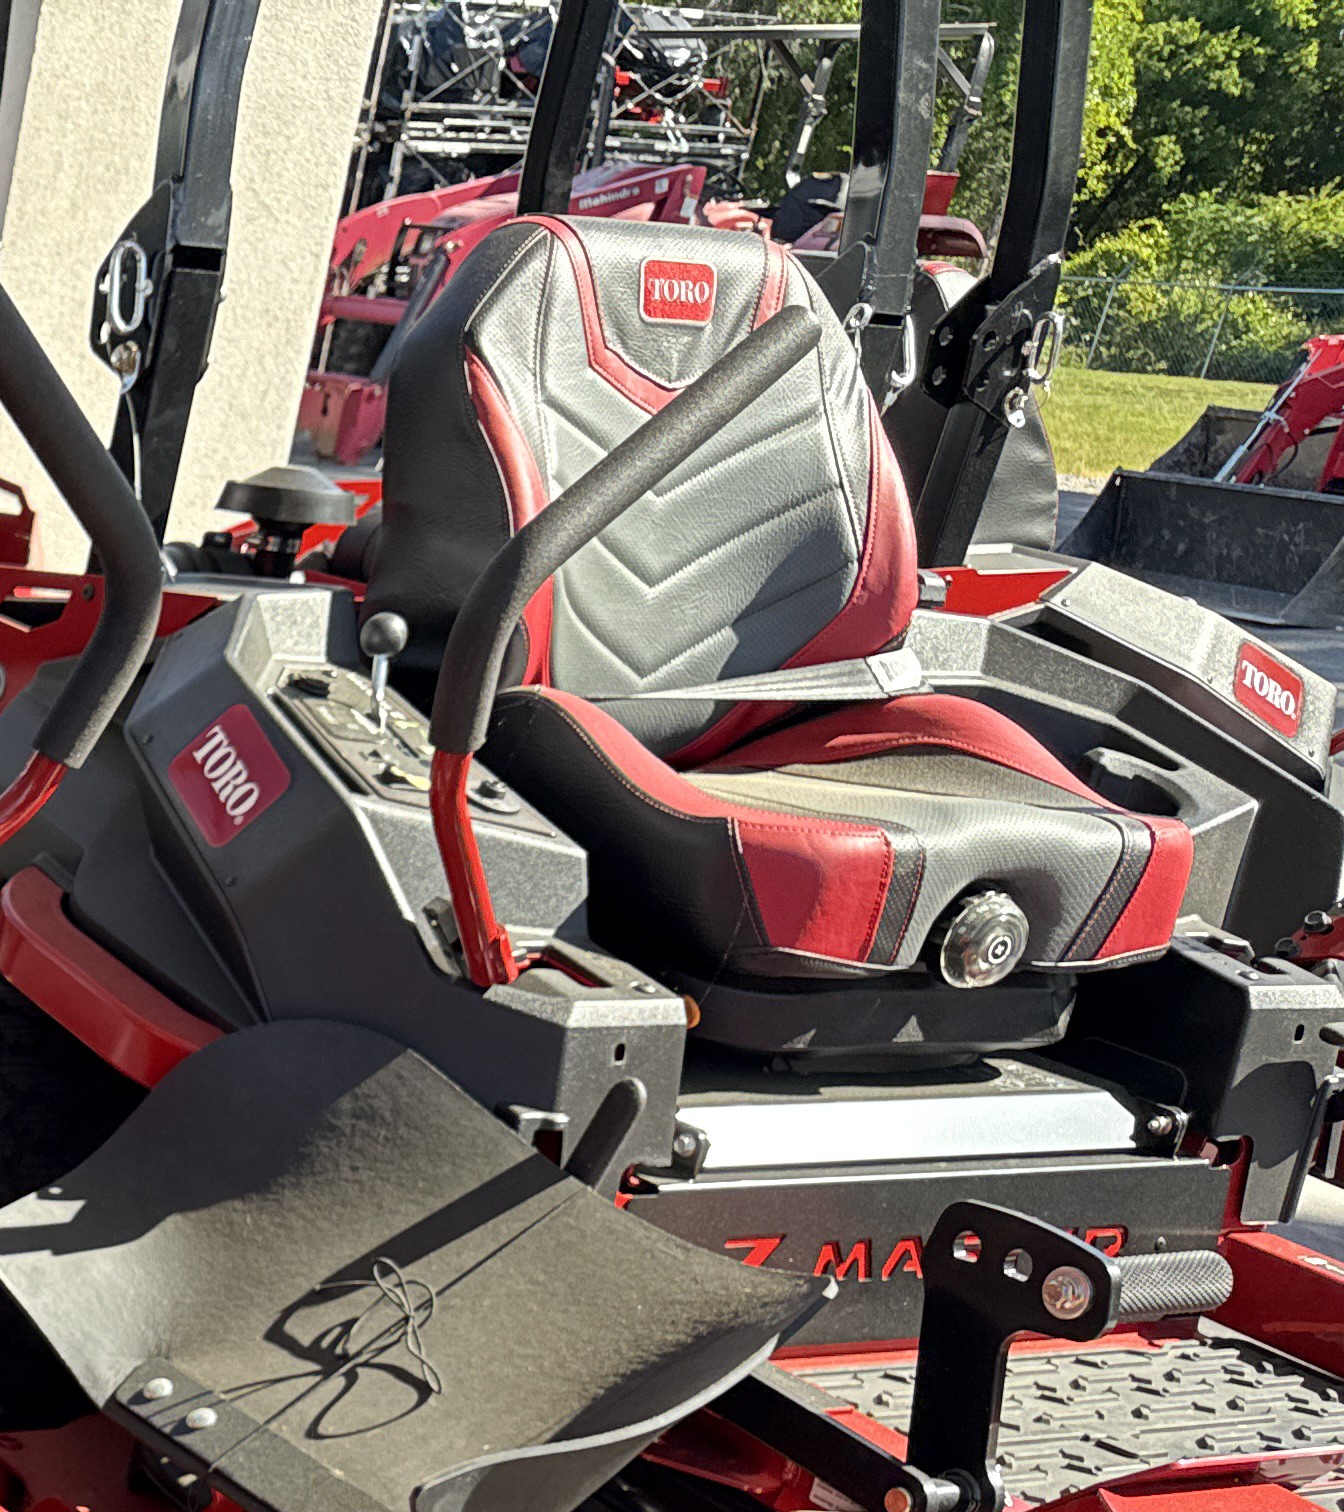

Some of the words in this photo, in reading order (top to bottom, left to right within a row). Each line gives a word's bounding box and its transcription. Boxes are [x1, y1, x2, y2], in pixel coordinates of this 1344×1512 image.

[578, 185, 640, 210] Mahindra
[647, 277, 710, 304] TORO
[1241, 659, 1295, 716] TORO
[193, 725, 260, 817] TORO
